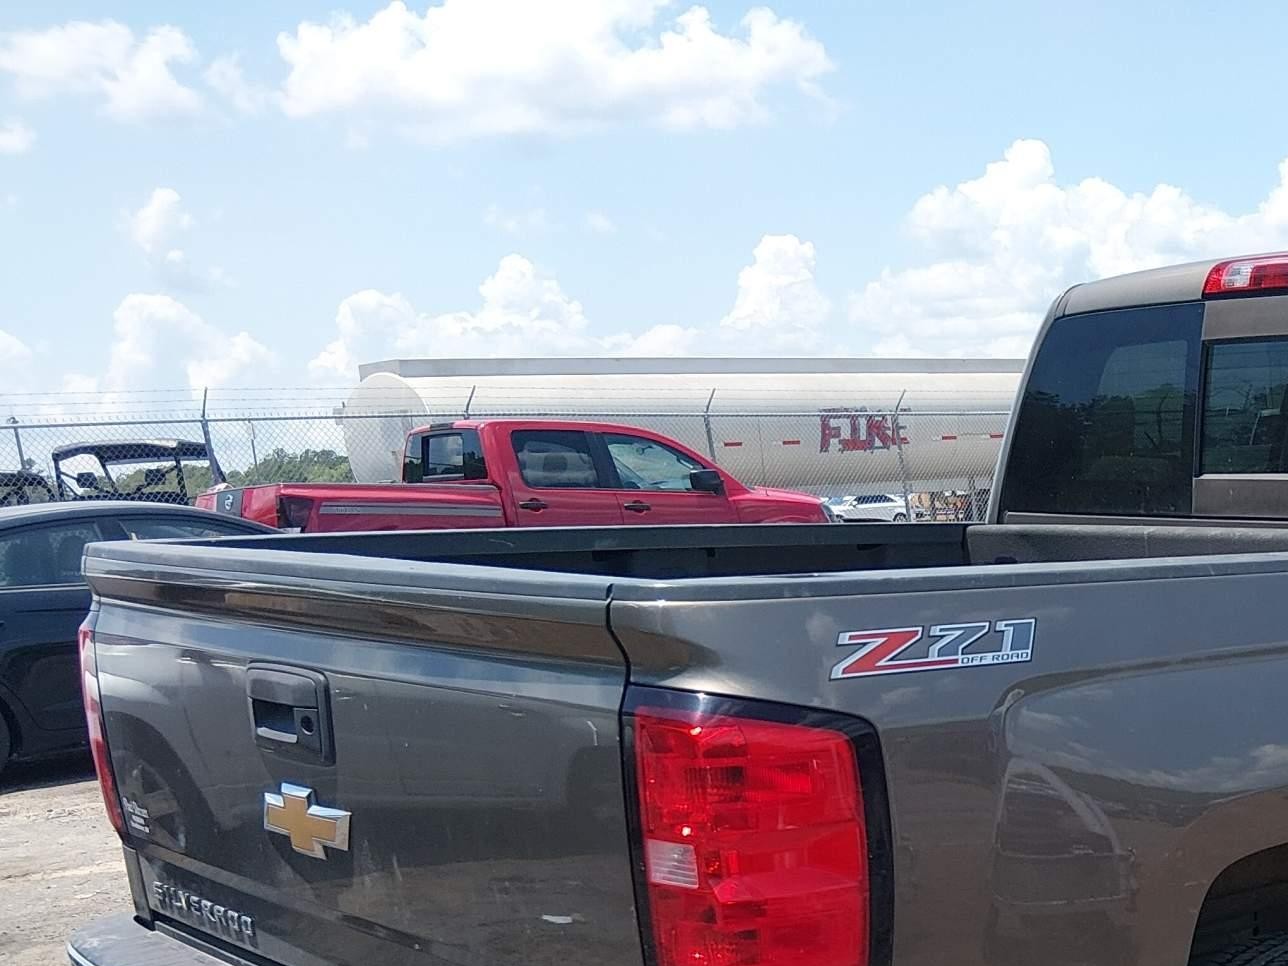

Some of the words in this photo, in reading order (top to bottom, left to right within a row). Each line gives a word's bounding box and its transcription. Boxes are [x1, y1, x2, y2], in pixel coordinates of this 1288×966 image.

[829, 617, 1036, 681] Z71
[960, 654, 987, 665] OFF
[991, 651, 1030, 662] ROAD
[153, 881, 254, 937] SILVERADO
